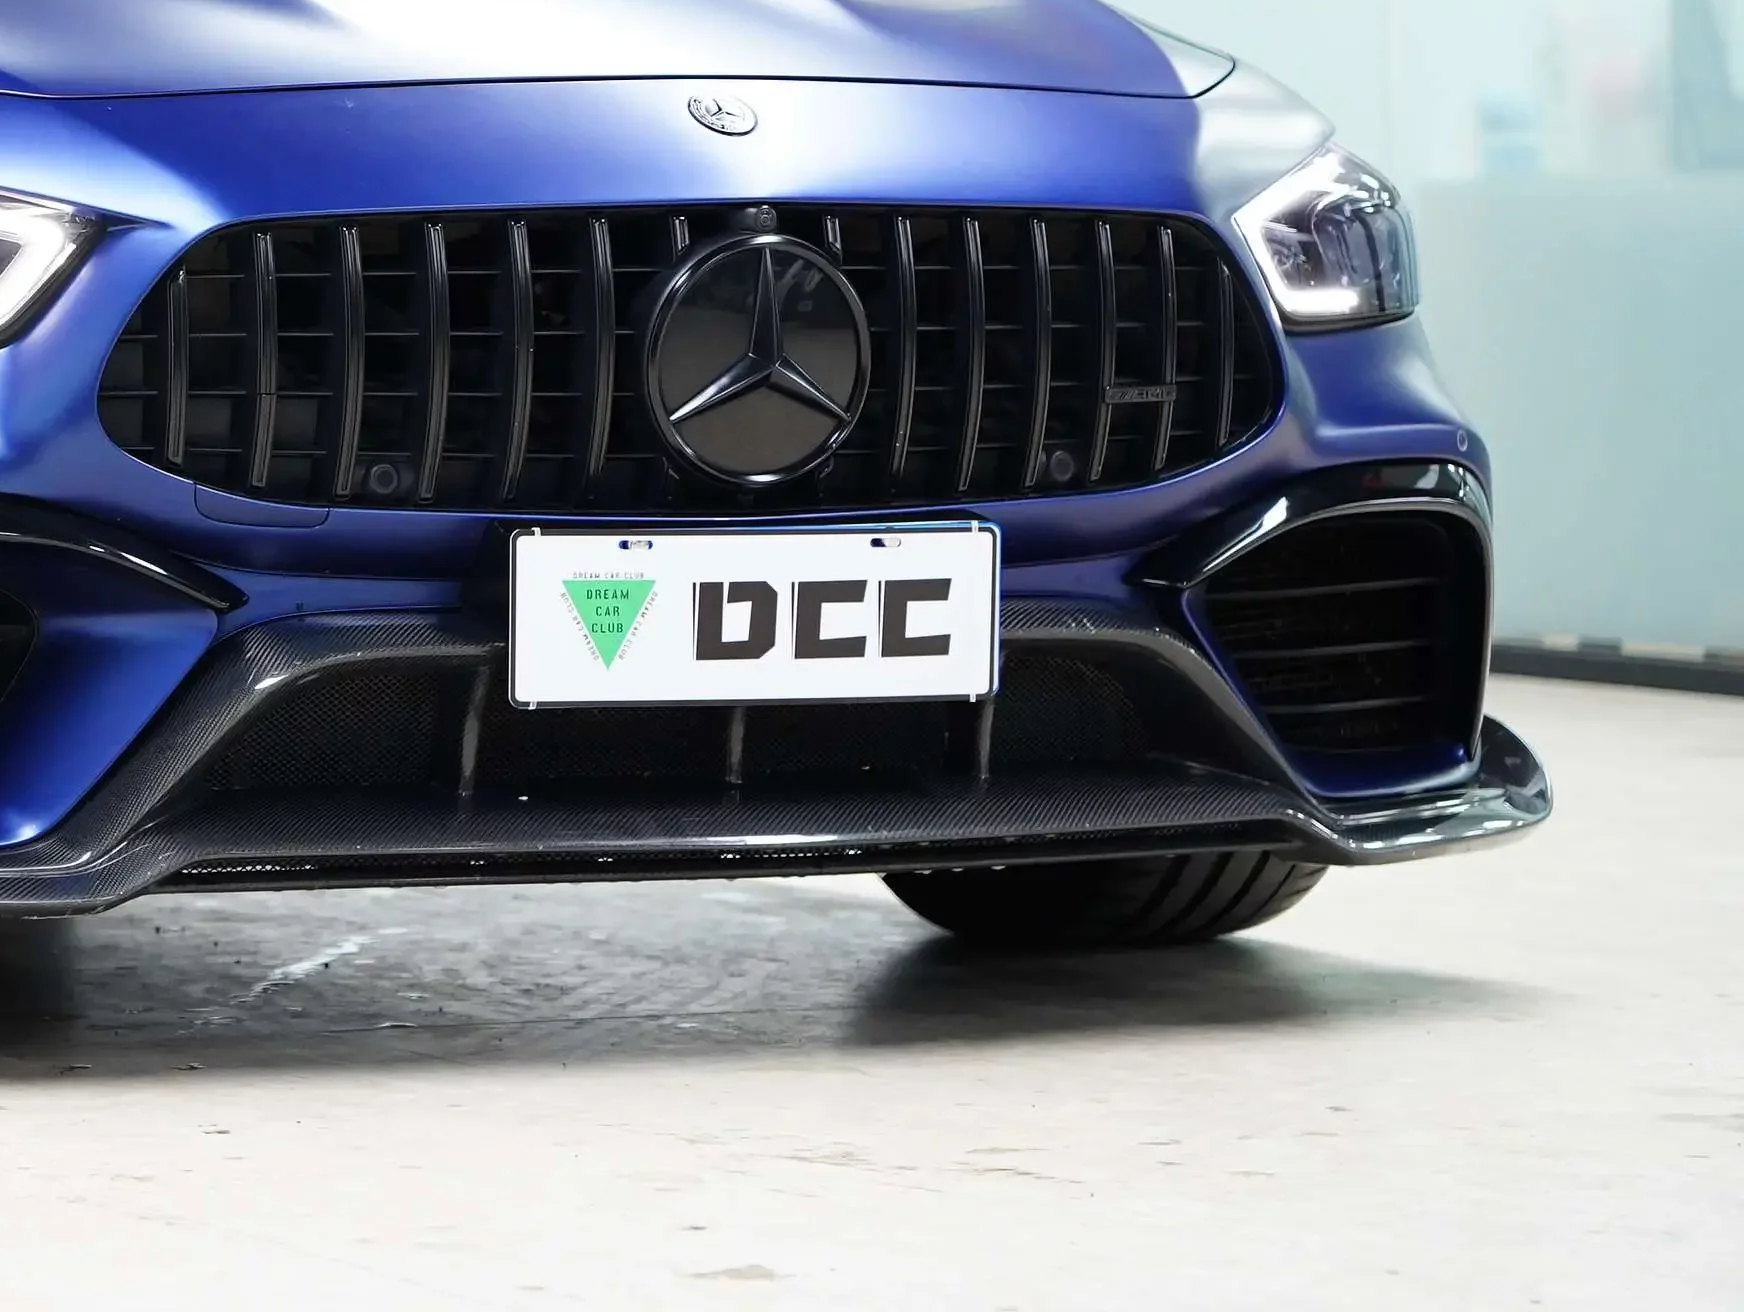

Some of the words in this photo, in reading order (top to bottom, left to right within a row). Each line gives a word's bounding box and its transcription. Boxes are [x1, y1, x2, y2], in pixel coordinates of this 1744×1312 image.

[586, 588, 630, 600] DREAM
[595, 605, 621, 617] CAR
[692, 577, 952, 661] DCC
[591, 622, 624, 633] CLUB
